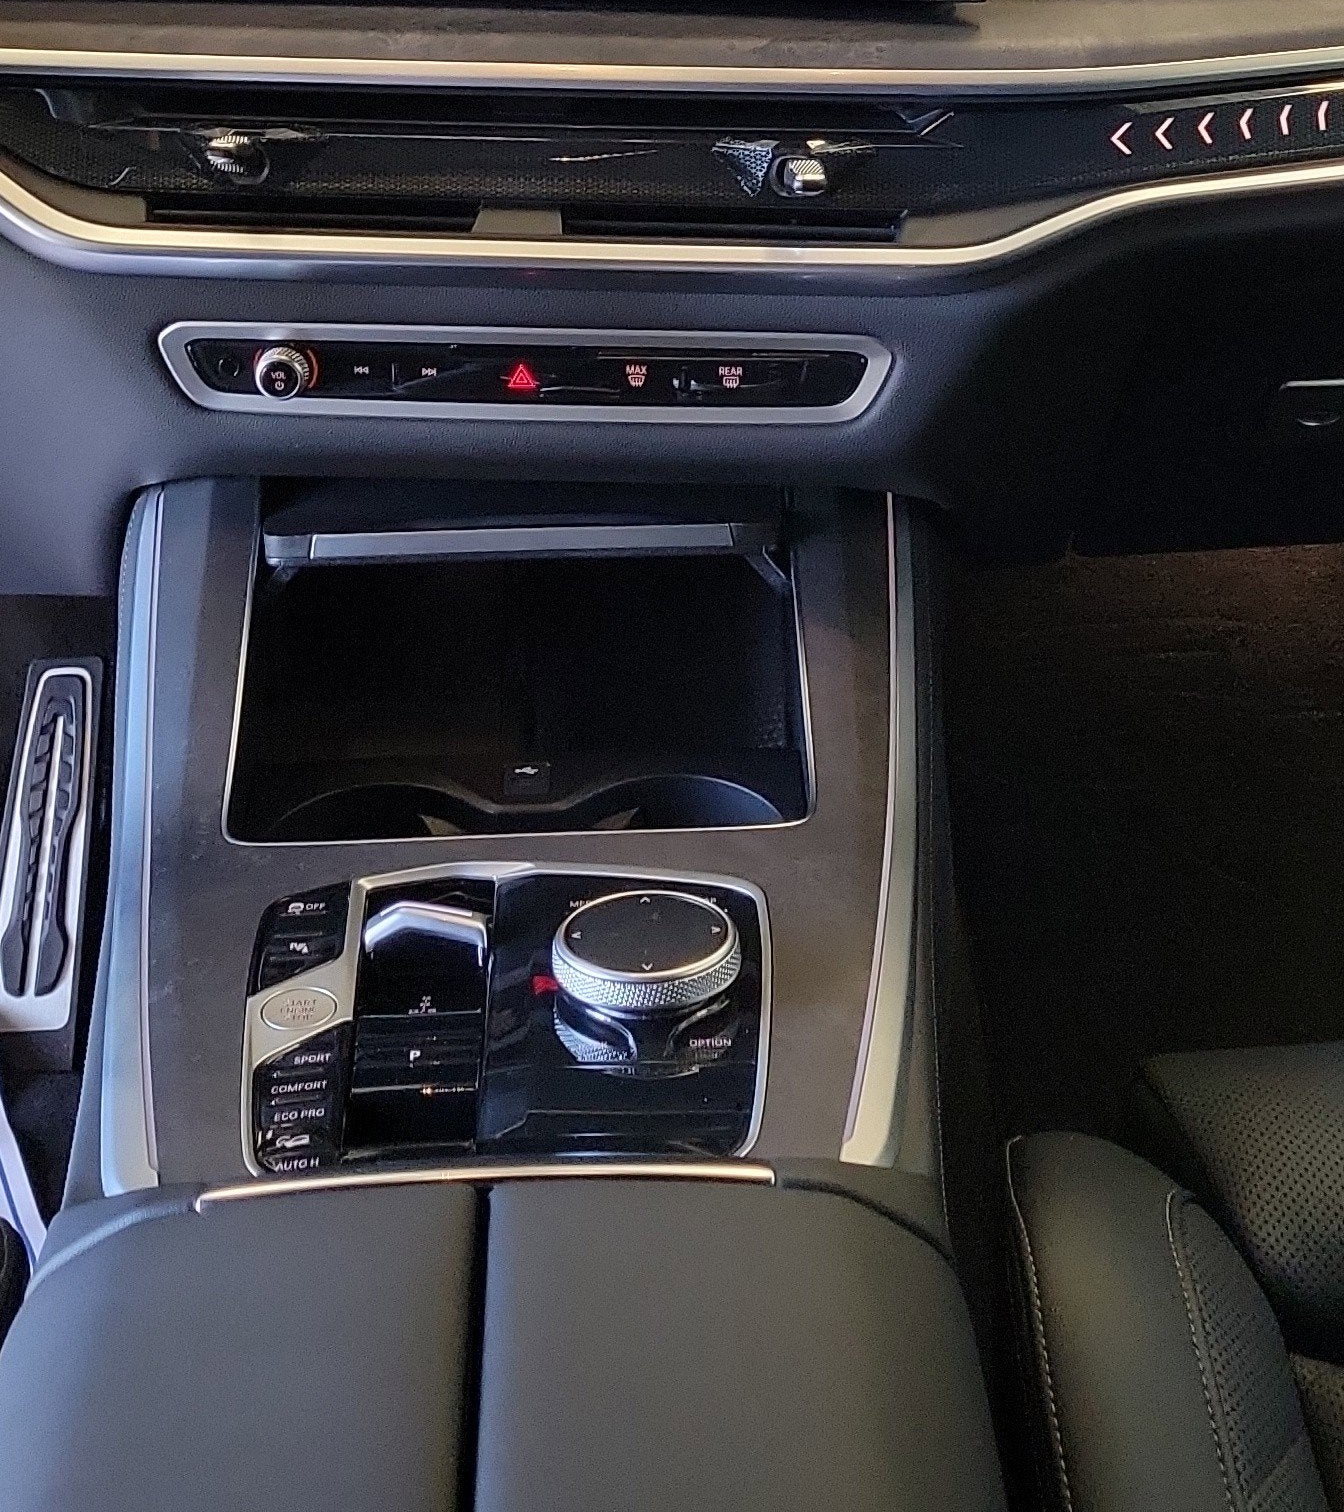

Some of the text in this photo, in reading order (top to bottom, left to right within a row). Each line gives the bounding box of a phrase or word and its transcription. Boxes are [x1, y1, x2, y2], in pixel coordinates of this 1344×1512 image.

[270, 370, 287, 381] VOL
[625, 364, 648, 376] MAX
[718, 365, 744, 377] REAR
[305, 902, 327, 912] OFF
[689, 1038, 733, 1048] OPTION
[293, 1052, 333, 1065] SPORT
[409, 1049, 422, 1062] P
[270, 1079, 328, 1095] COMFORT
[273, 1107, 326, 1123] ECO PRO
[275, 1156, 320, 1172] AUTO H
